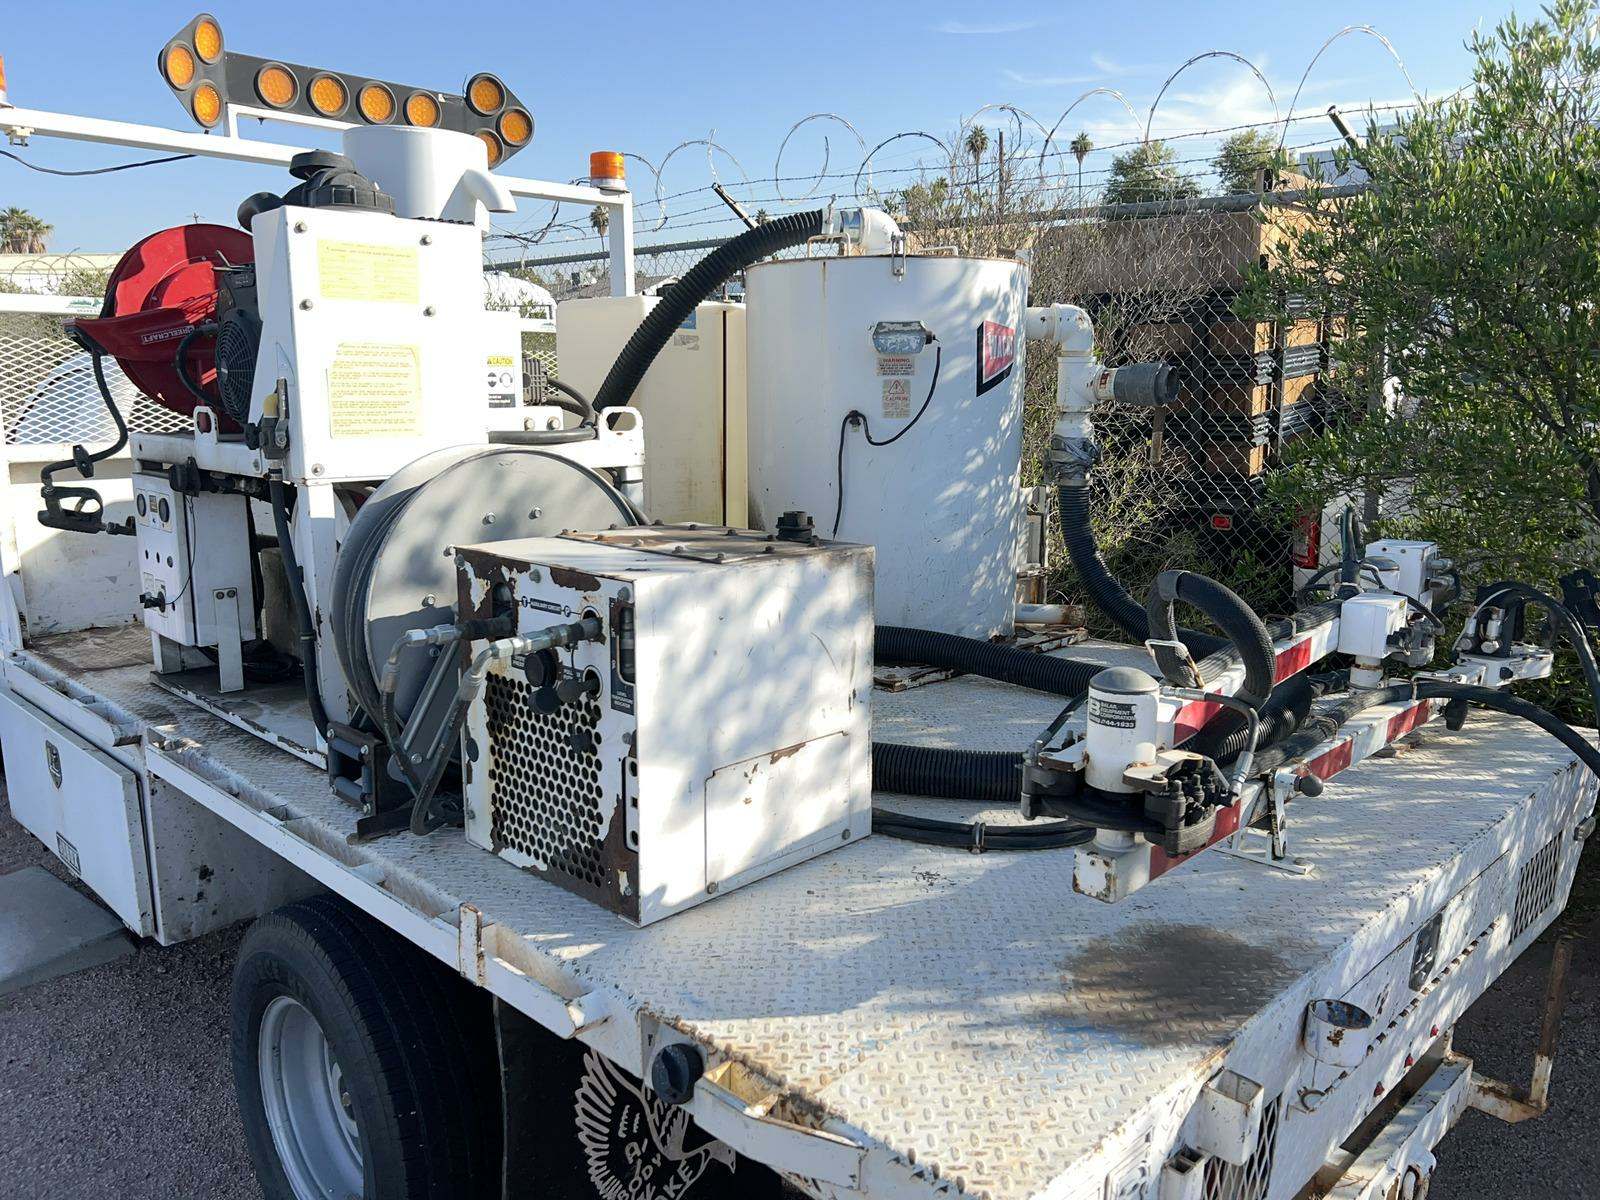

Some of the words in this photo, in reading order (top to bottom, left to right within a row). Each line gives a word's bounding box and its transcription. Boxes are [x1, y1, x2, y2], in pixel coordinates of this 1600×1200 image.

[144, 327, 189, 342] REELCRAFT
[1100, 708, 1130, 716] EQUIPMENT
[1100, 712, 1136, 721] CORPORATION
